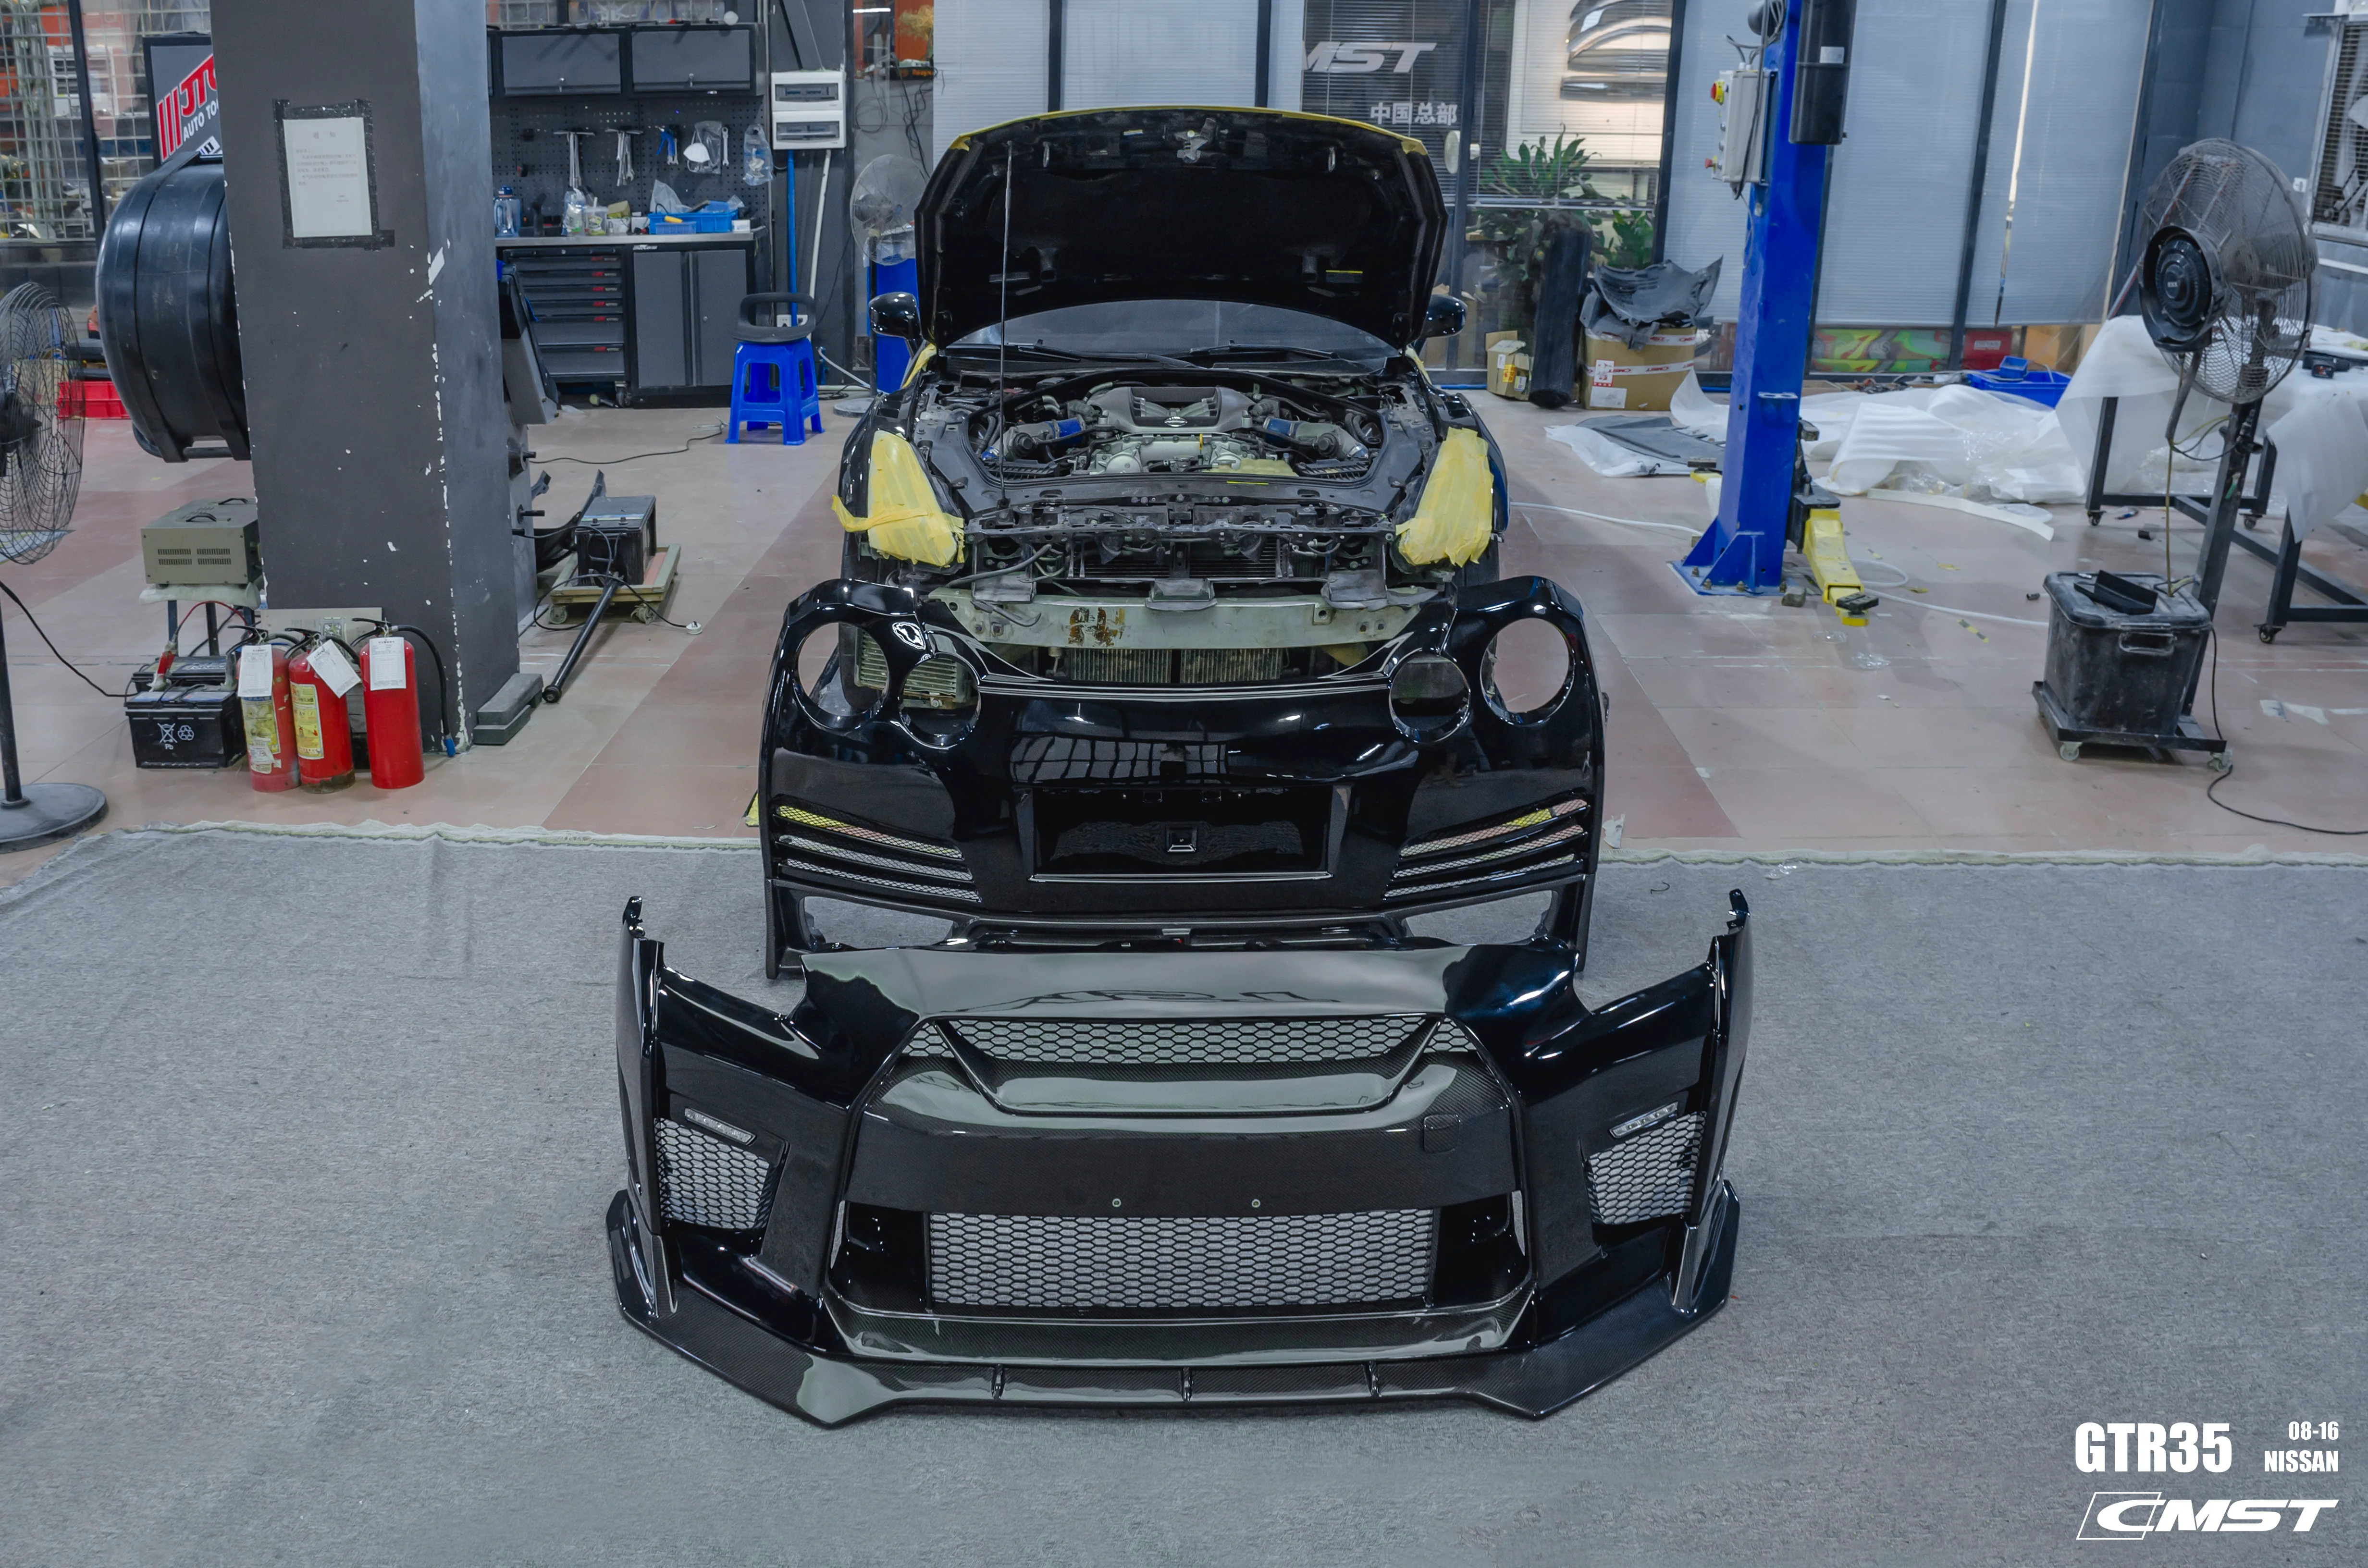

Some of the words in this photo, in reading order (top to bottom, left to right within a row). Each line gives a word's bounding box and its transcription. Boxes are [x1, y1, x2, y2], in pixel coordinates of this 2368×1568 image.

[179, 53, 217, 117] JT
[184, 111, 205, 142] AUTO
[206, 98, 219, 120] TO
[1370, 102, 1458, 125] 中国总部
